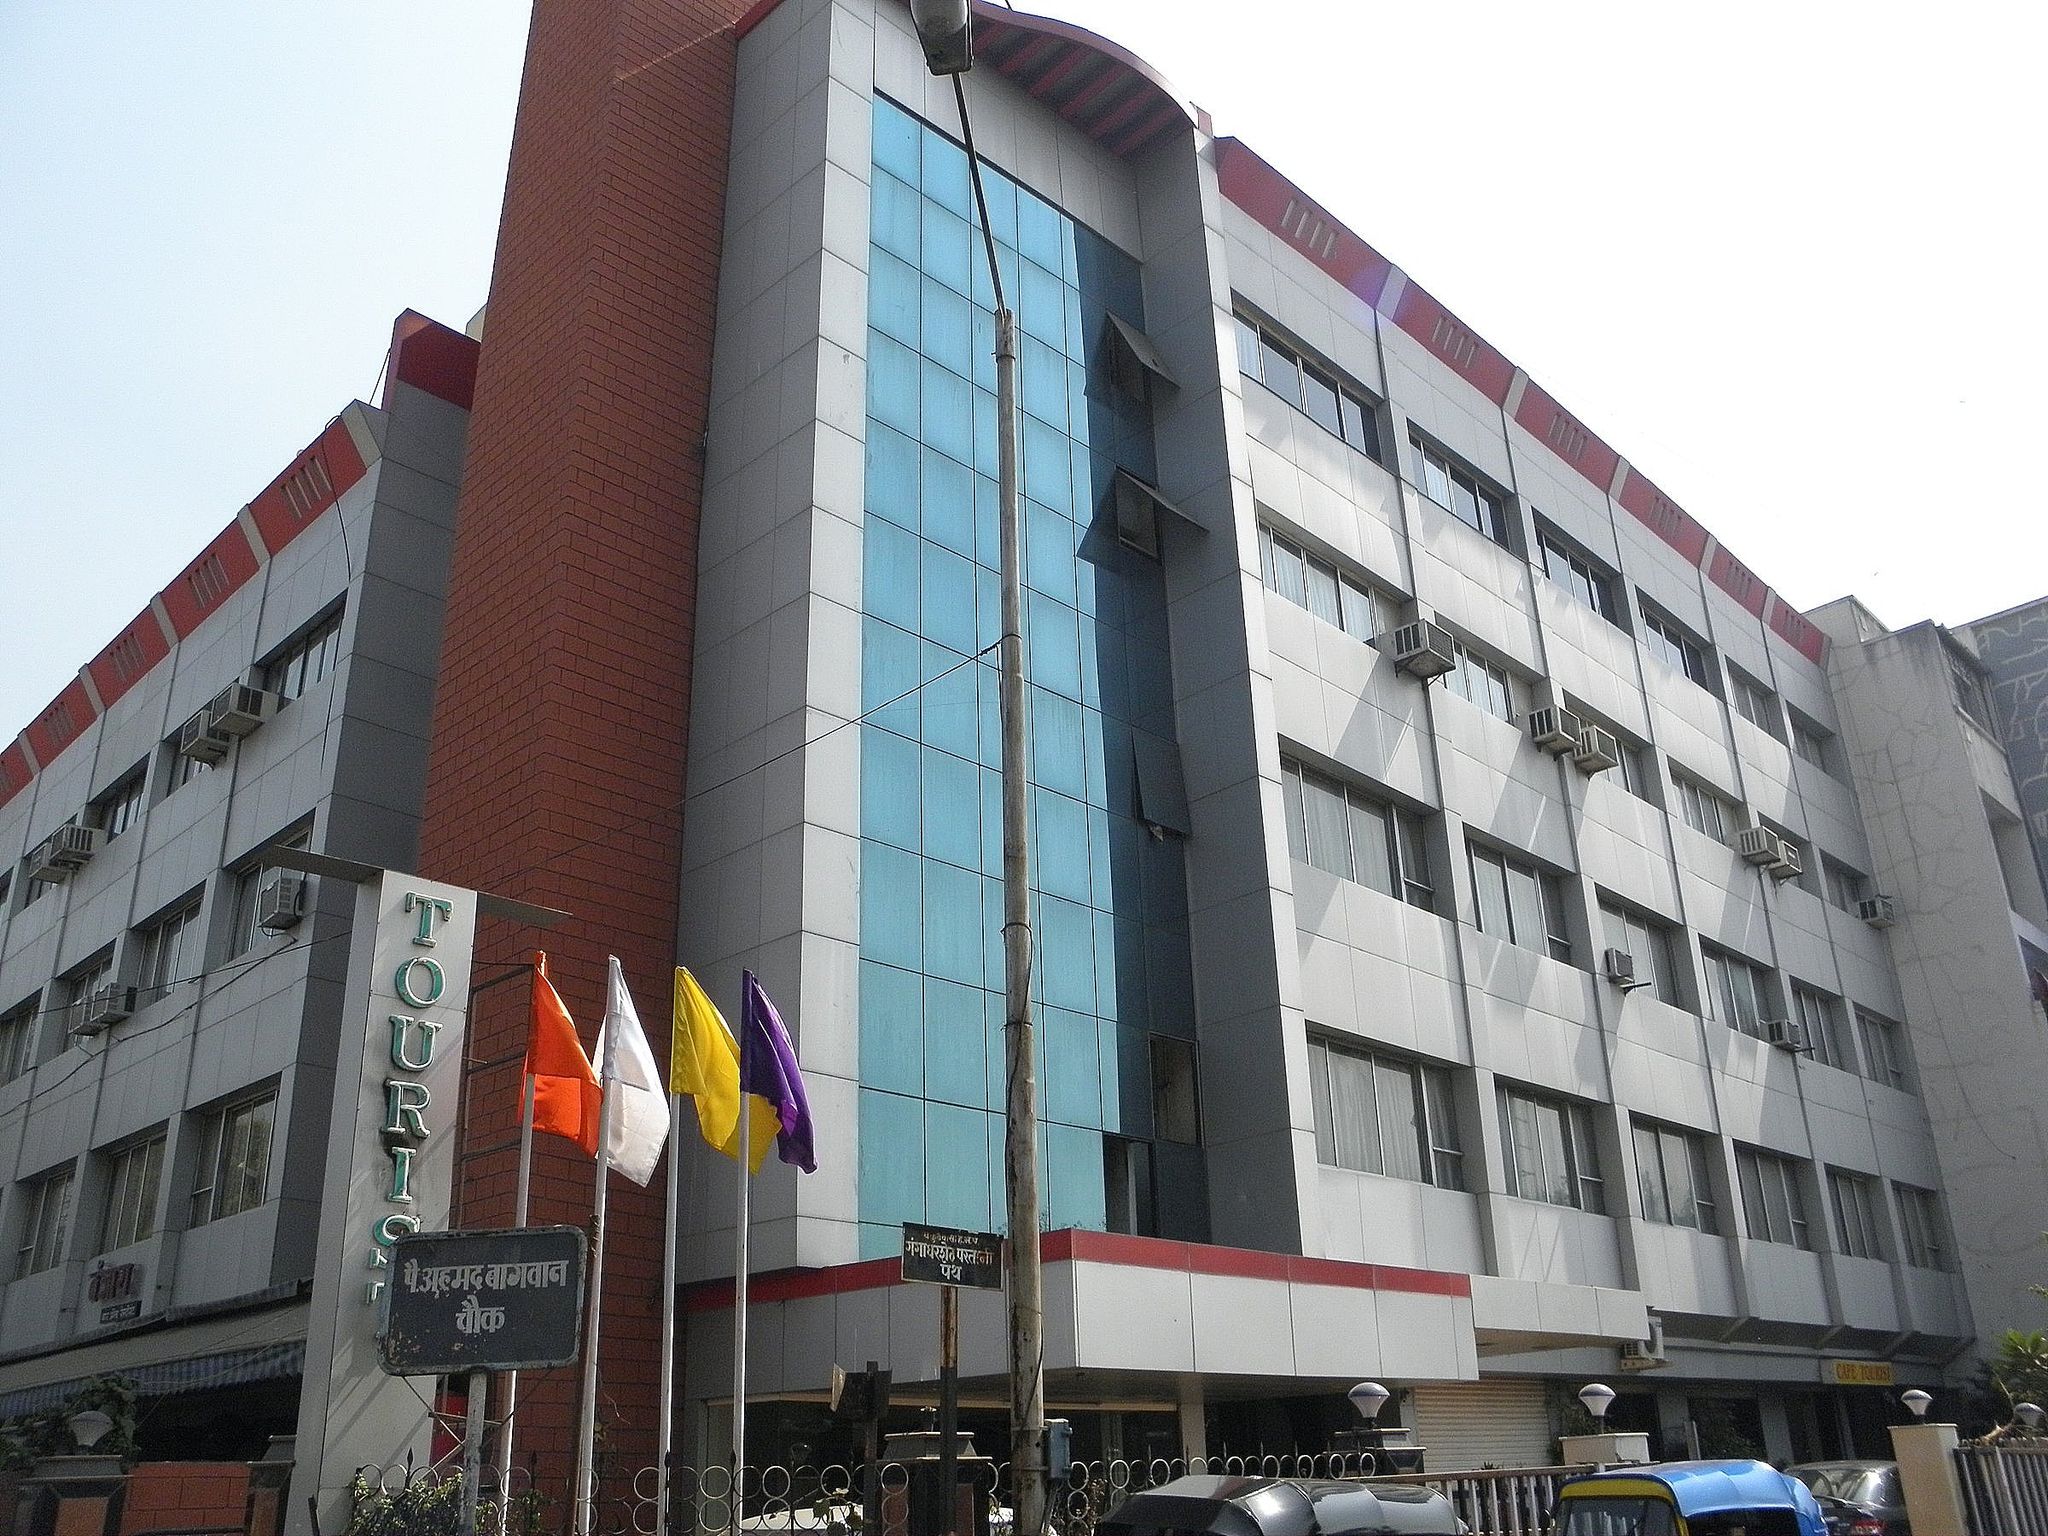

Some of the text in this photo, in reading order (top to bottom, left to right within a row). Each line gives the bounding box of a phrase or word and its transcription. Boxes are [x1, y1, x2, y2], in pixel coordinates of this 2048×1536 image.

[485, 1260, 570, 1291] बागवान
[940, 1264, 963, 1281] पथ
[455, 1295, 506, 1335] चौक
